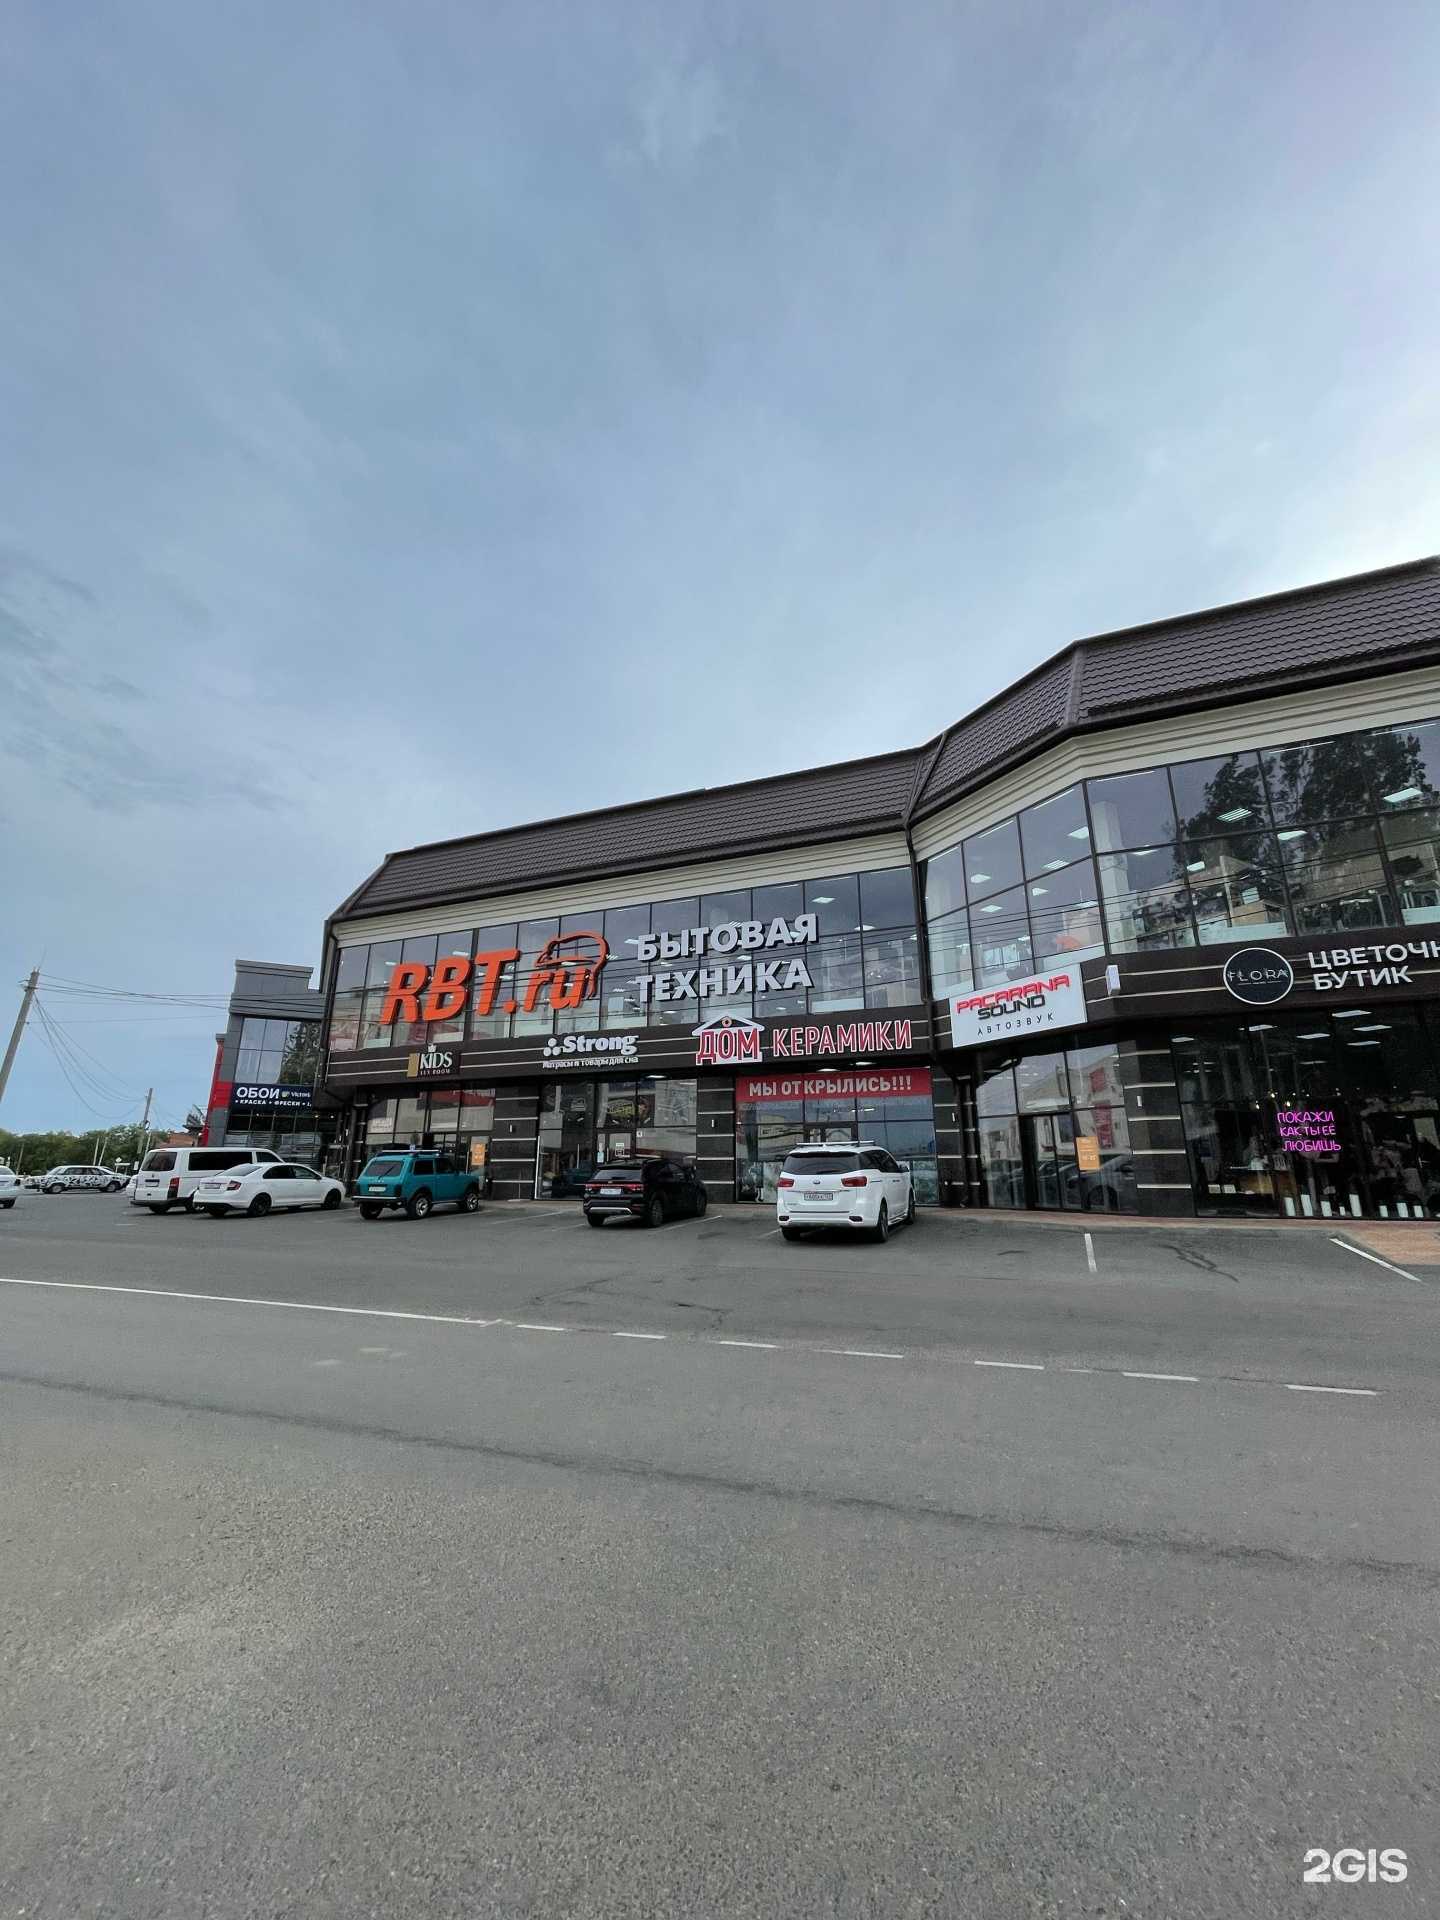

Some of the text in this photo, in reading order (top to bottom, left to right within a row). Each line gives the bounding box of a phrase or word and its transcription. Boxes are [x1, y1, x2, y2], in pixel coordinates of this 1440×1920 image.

[637, 912, 819, 963] БЫТОВАЯ
[635, 958, 815, 1005] ТЕХНИКА
[1228, 968, 1289, 982] FLORA
[1312, 965, 1414, 991] БУТИК
[380, 948, 588, 1025] RBT.ru
[956, 974, 1070, 1014] PACARANA
[978, 995, 1046, 1020] SOUND
[977, 1012, 1054, 1036] АВТОЗВУК
[562, 1035, 640, 1055] Strong
[695, 1019, 913, 1065] ДОМ КЕРАМИКИ
[420, 1051, 453, 1069] KIDS
[236, 1087, 280, 1099] ОБОИ
[749, 1082, 777, 1097] МЫ
[1277, 1111, 1335, 1123] ПОКАЖИ
[1280, 1126, 1302, 1137] КАК
[1304, 1126, 1320, 1136] ТЫ
[1282, 1139, 1342, 1152] ЛЮБИШЬ
